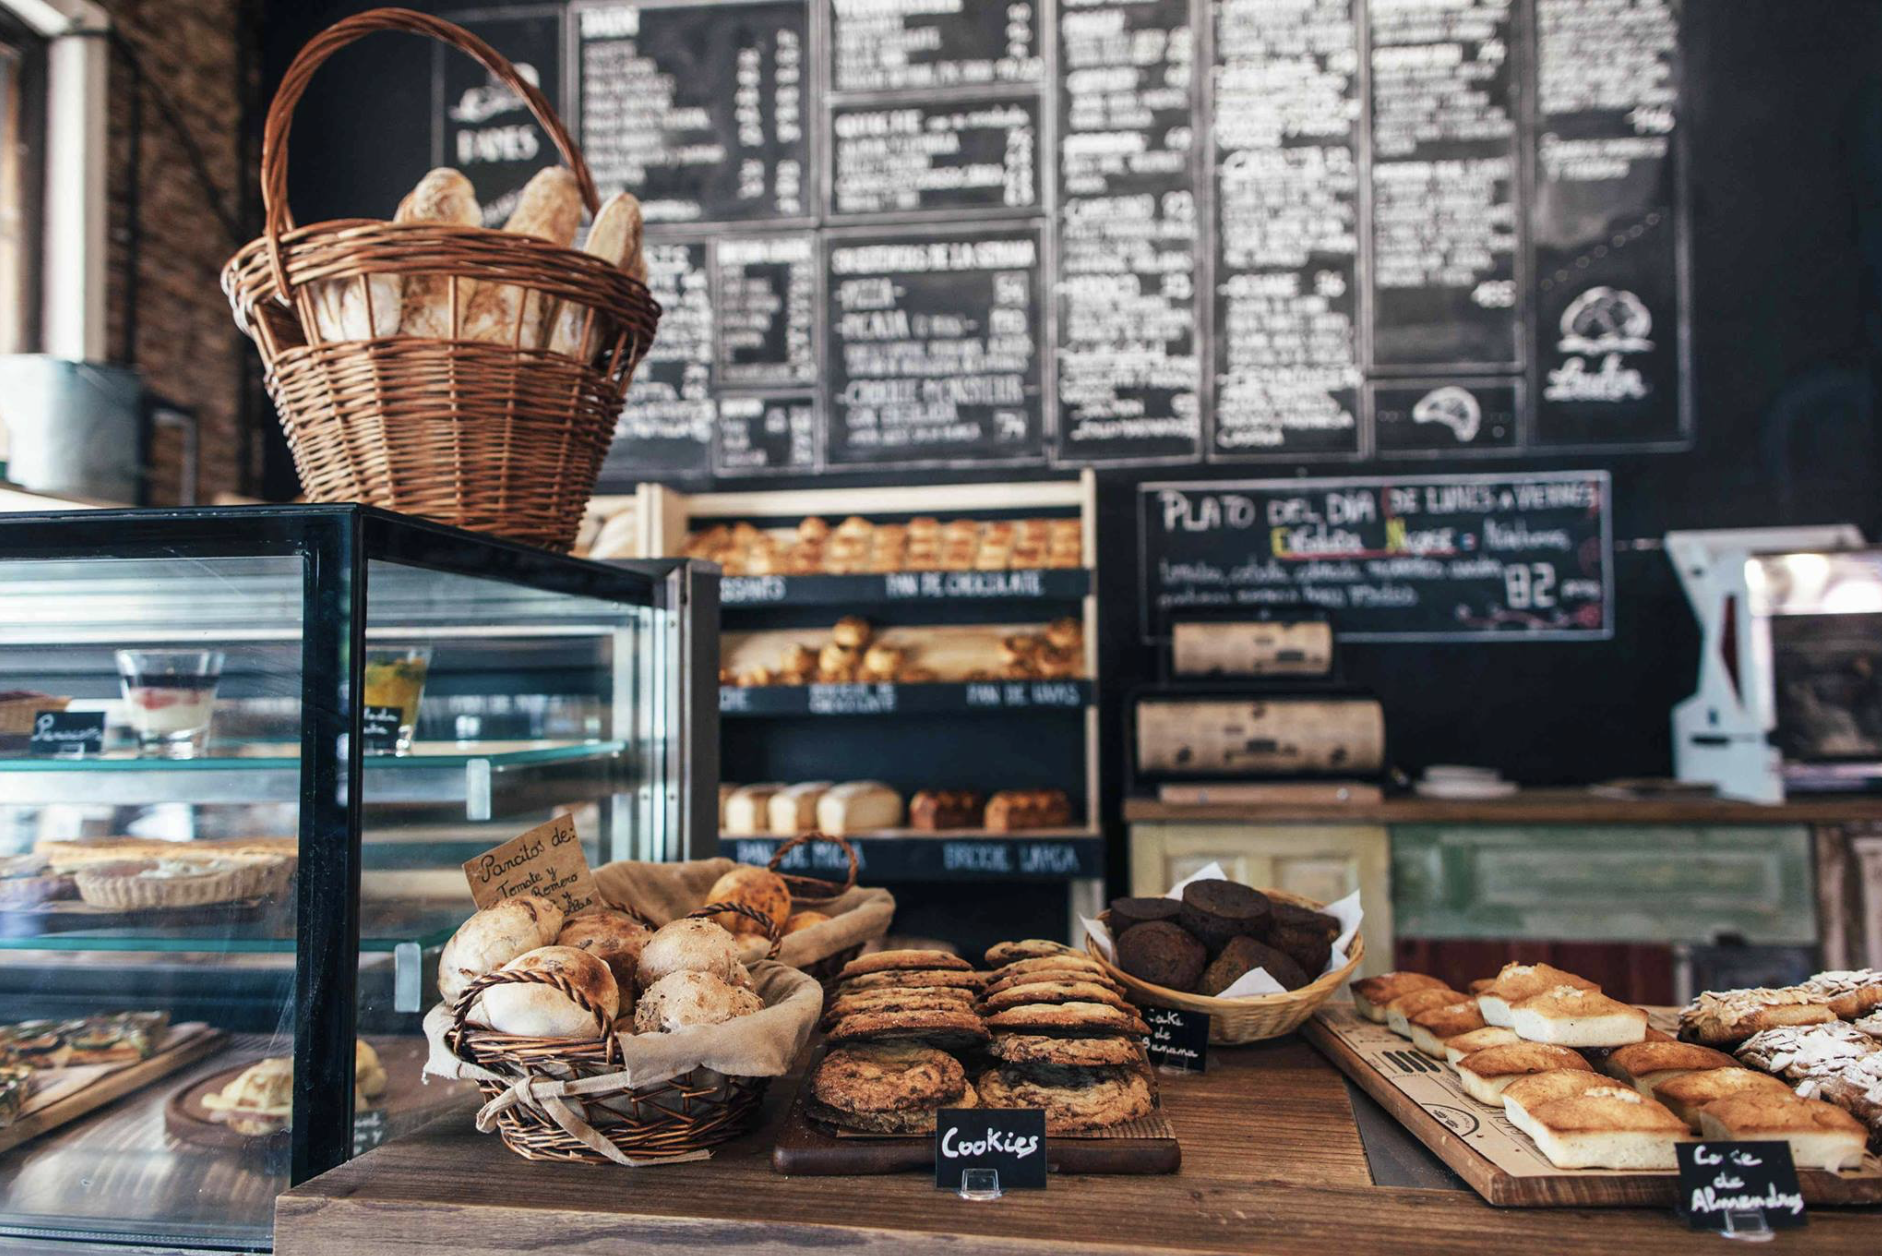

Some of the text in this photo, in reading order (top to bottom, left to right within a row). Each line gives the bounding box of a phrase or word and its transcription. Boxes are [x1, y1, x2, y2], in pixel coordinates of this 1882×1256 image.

[1158, 490, 1256, 531] PLATO
[480, 840, 545, 883] Pancitos
[495, 872, 543, 899] Tomate
[531, 872, 578, 898] Romero
[1155, 1026, 1171, 1040] de
[1713, 1172, 1745, 1189] de
